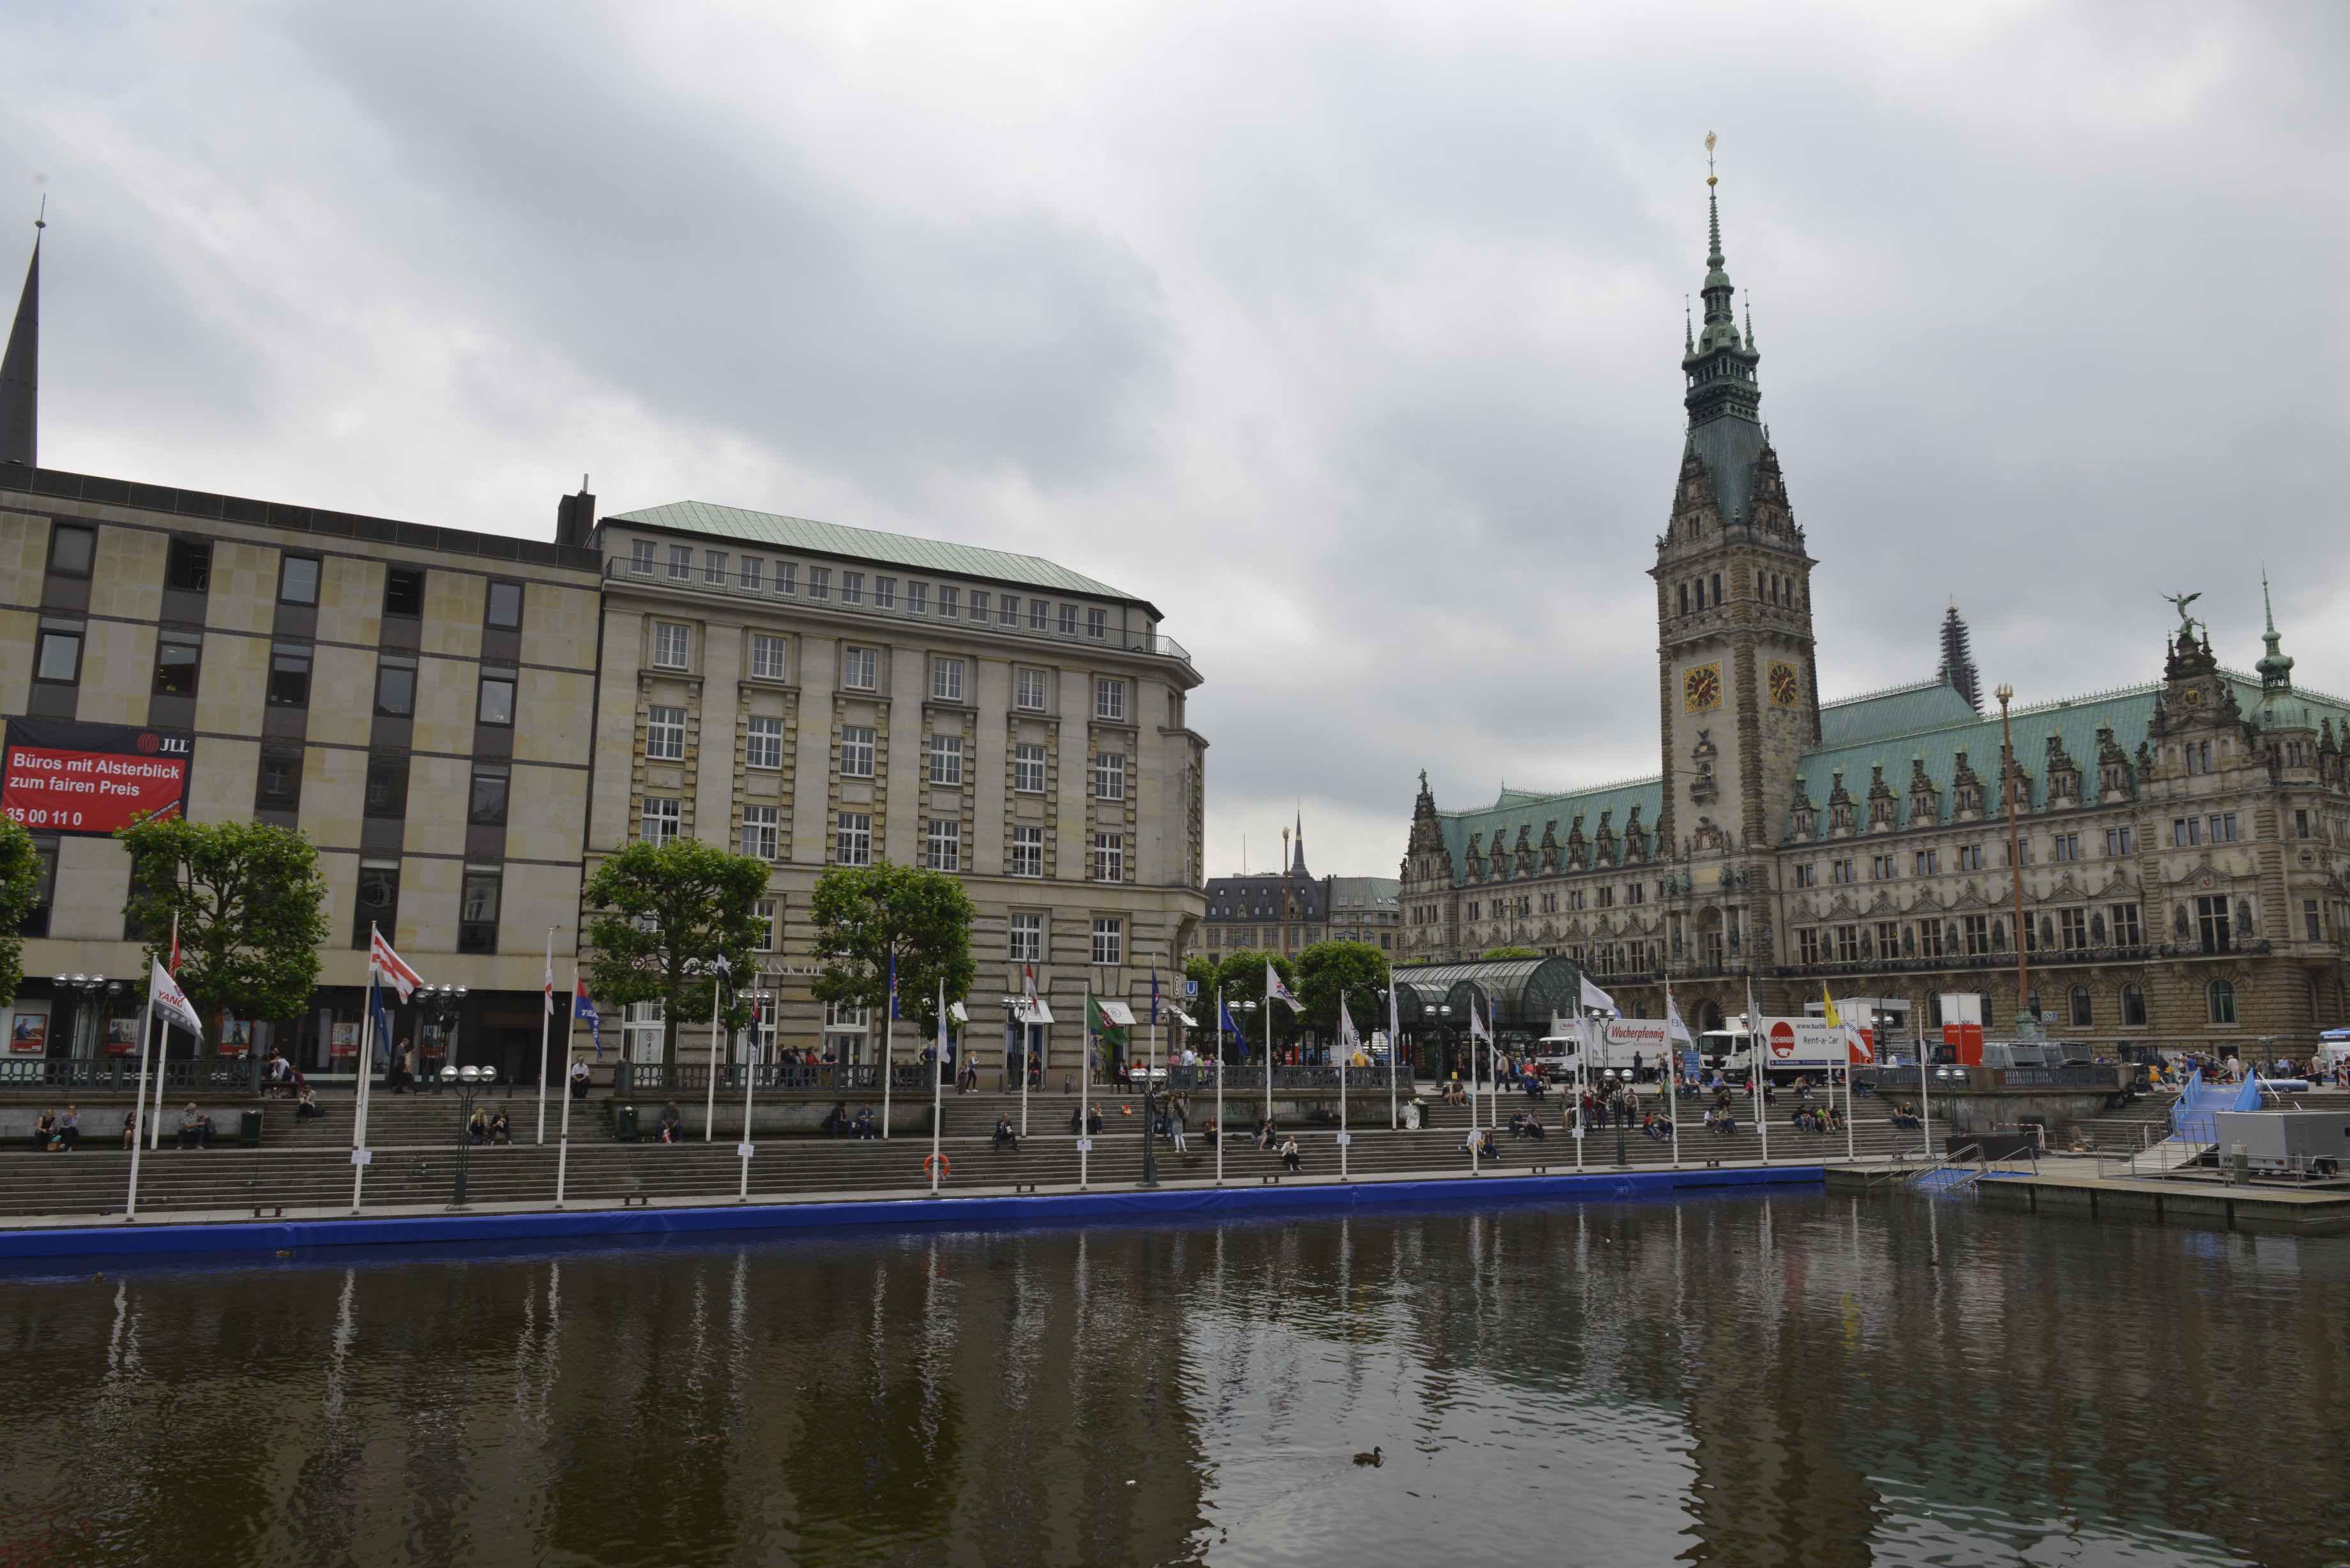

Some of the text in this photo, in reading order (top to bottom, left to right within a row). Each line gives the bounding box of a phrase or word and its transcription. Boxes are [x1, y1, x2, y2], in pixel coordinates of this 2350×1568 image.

[160, 738, 189, 753] JLL
[13, 753, 179, 779] Büros mit Alsterblick
[10, 776, 140, 796] zum fairen Preis
[6, 807, 82, 826] 35 00 11 0
[1187, 982, 1196, 994] U
[158, 990, 185, 1007] YANG
[1611, 1025, 1665, 1043] Wucherpfennig
[1803, 1036, 1839, 1044] Rent-a-Car
